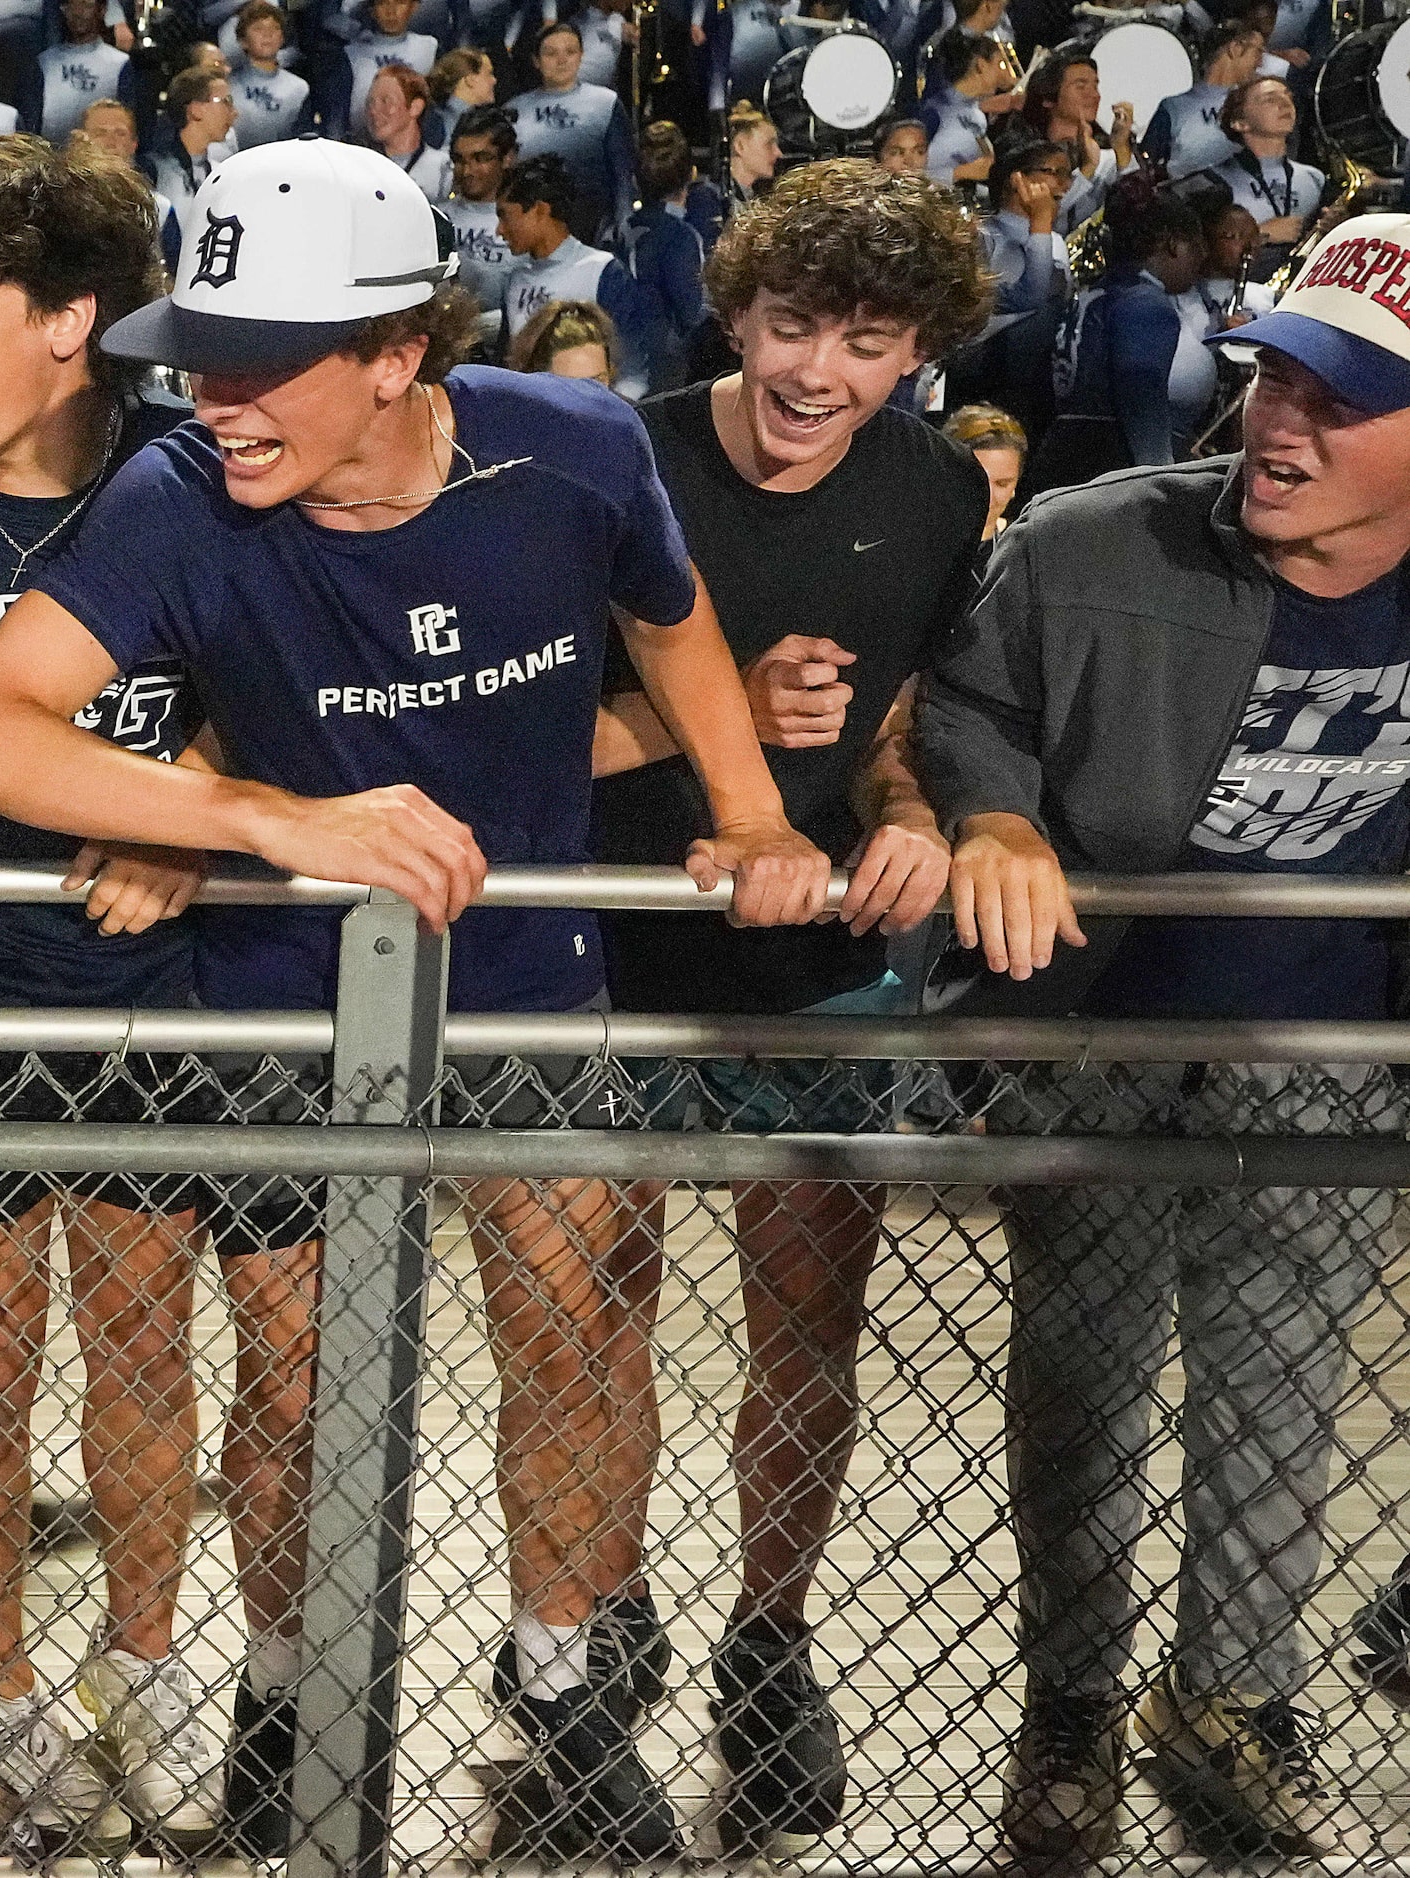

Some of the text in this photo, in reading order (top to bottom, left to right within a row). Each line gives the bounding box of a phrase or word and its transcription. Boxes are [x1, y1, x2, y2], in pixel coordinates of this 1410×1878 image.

[189, 206, 245, 289] D
[406, 603, 461, 656] PG
[317, 633, 577, 719] PERFECT GAME
[1235, 757, 1407, 775] WILDCATS
